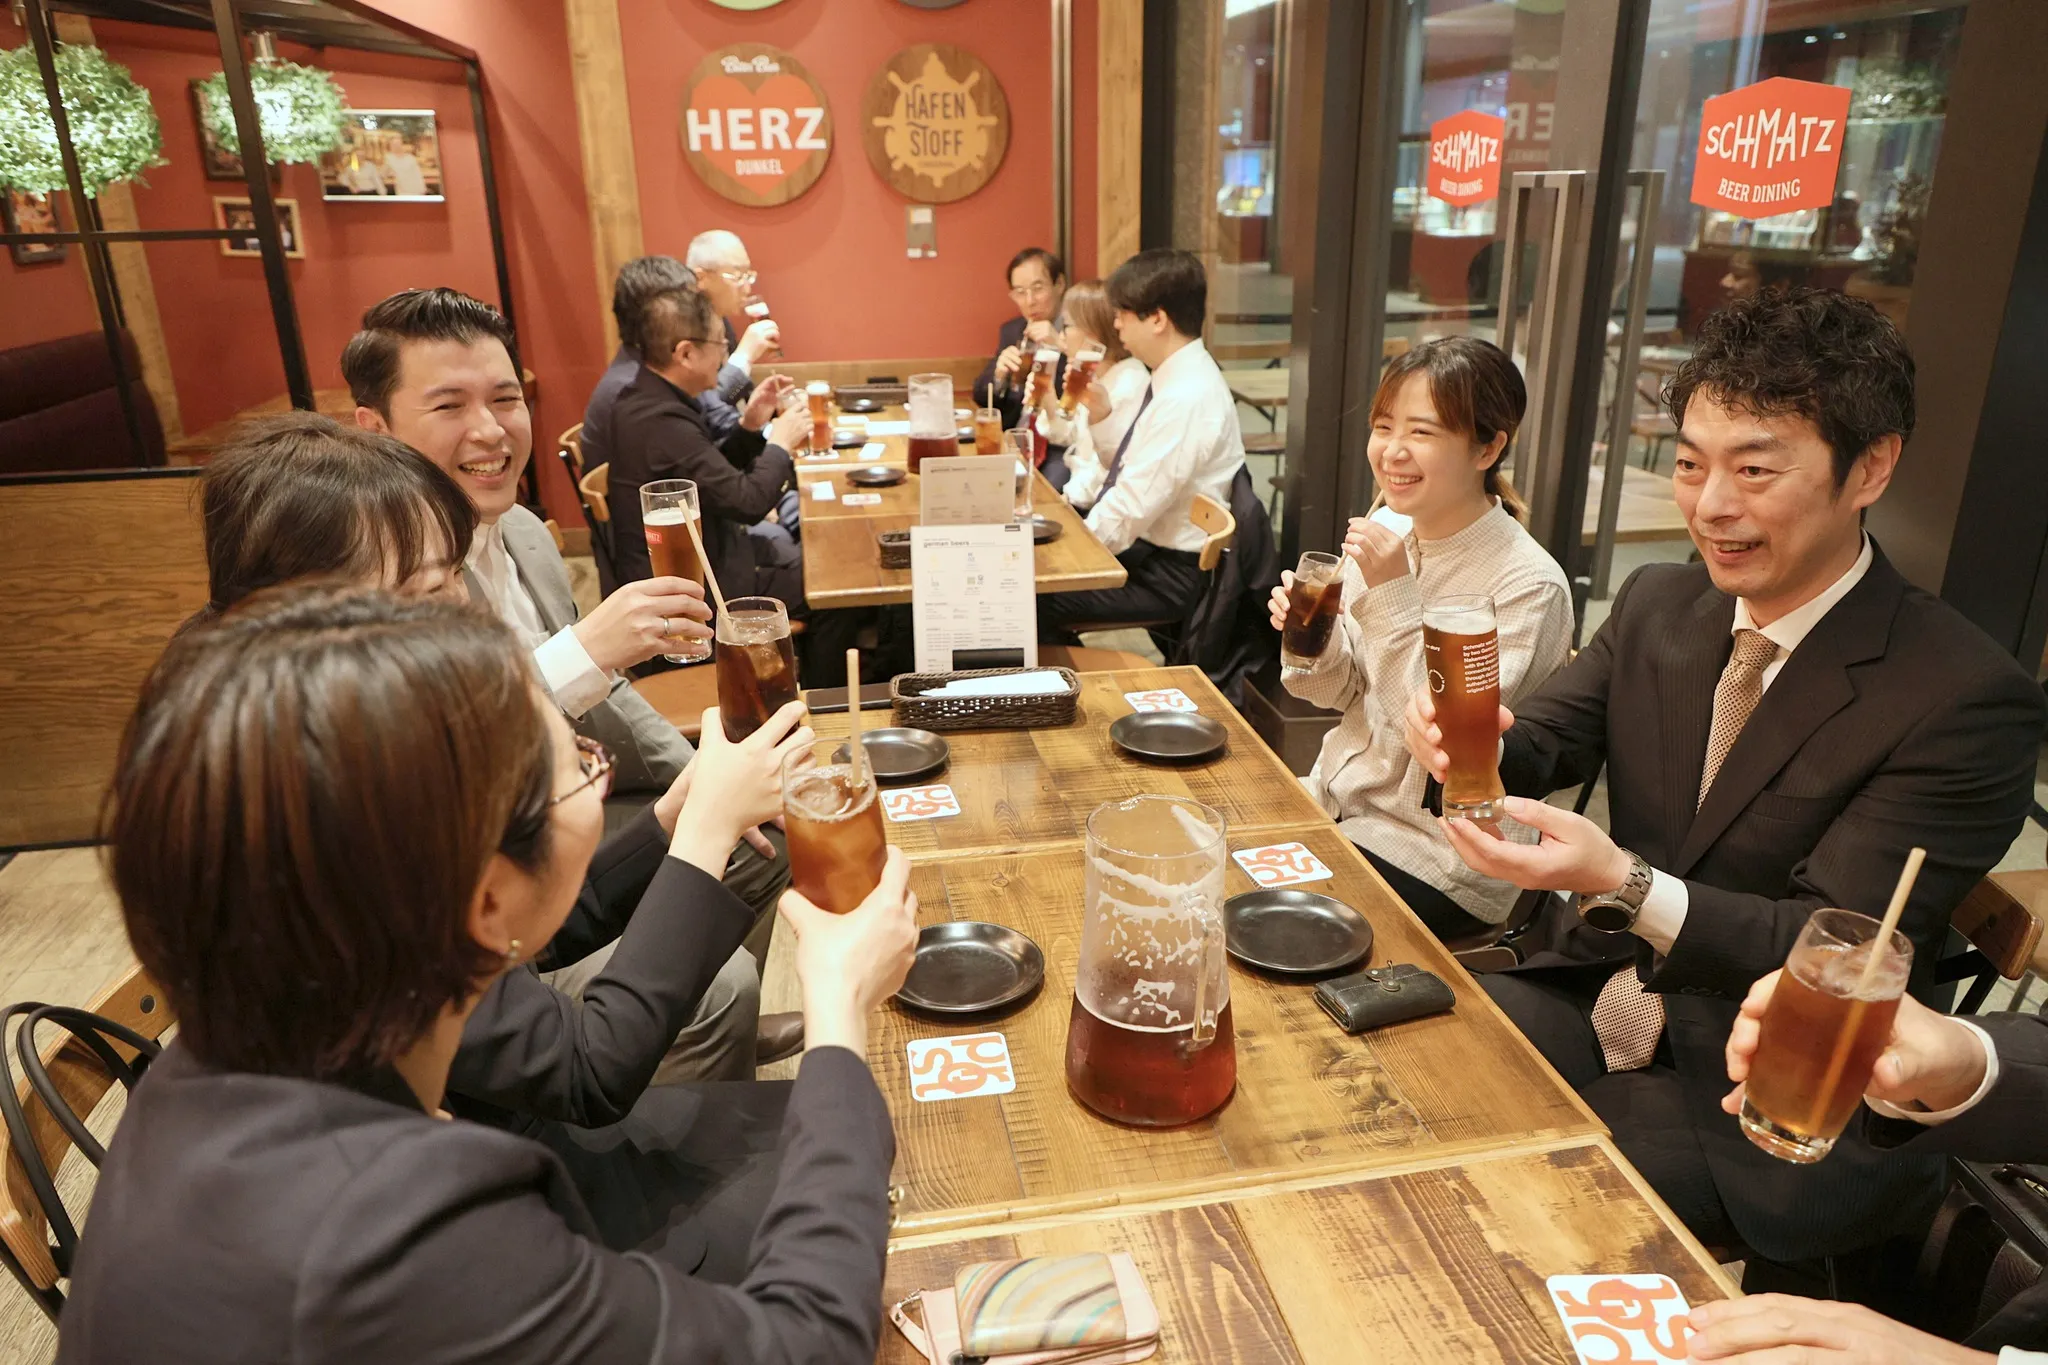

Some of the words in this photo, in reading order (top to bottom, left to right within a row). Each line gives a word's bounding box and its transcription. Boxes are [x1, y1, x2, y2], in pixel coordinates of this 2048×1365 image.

[905, 84, 966, 120] HAFEN
[686, 106, 827, 152] HERZ
[907, 122, 964, 157] STOFF
[1705, 107, 1836, 169] SCHMATZ
[735, 158, 784, 176] DUNKEL
[1432, 129, 1498, 173] SCHMATZ
[1440, 177, 1457, 196] BEER
[1457, 178, 1483, 197] DINING
[1717, 177, 1751, 202] BEER
[1752, 178, 1801, 203] DINING
